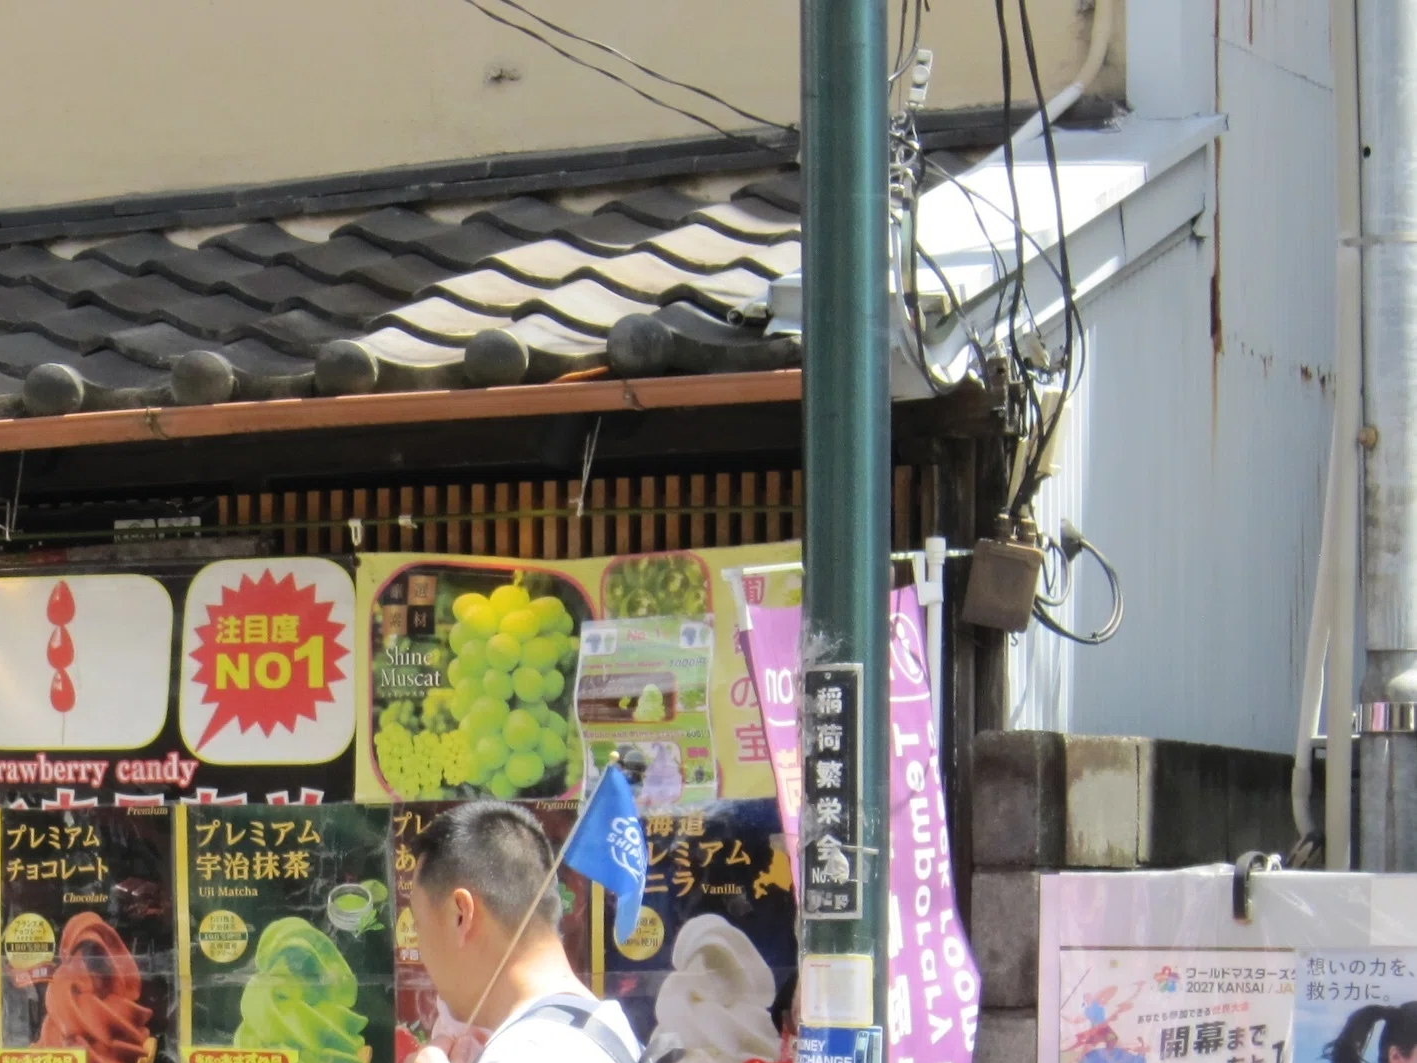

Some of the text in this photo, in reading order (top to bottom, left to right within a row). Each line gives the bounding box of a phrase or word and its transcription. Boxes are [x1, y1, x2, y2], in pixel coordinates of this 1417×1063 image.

[215, 615, 300, 644] 注目度
[214, 635, 325, 689] NO1
[385, 646, 433, 665] Shine
[381, 668, 441, 687] Muscat
[116, 754, 199, 787] candy
[816, 686, 844, 863] 稲荷繁栄会
[127, 807, 169, 816] Premium
[6, 824, 101, 850] プレミアム
[195, 818, 322, 848] プレミアム
[6, 857, 110, 882] チョコレート
[195, 851, 311, 881] 宇治抹茶
[62, 892, 109, 904] Chocolate
[198, 886, 259, 898] Uji Matcha
[700, 883, 743, 895] Vanilla
[1306, 956, 1415, 977] 想いの力を、
[1185, 982, 1265, 994] 2027 KANSAI
[1306, 981, 1397, 1003] 救う力に。
[1159, 1020, 1268, 1061] 開幕まで
